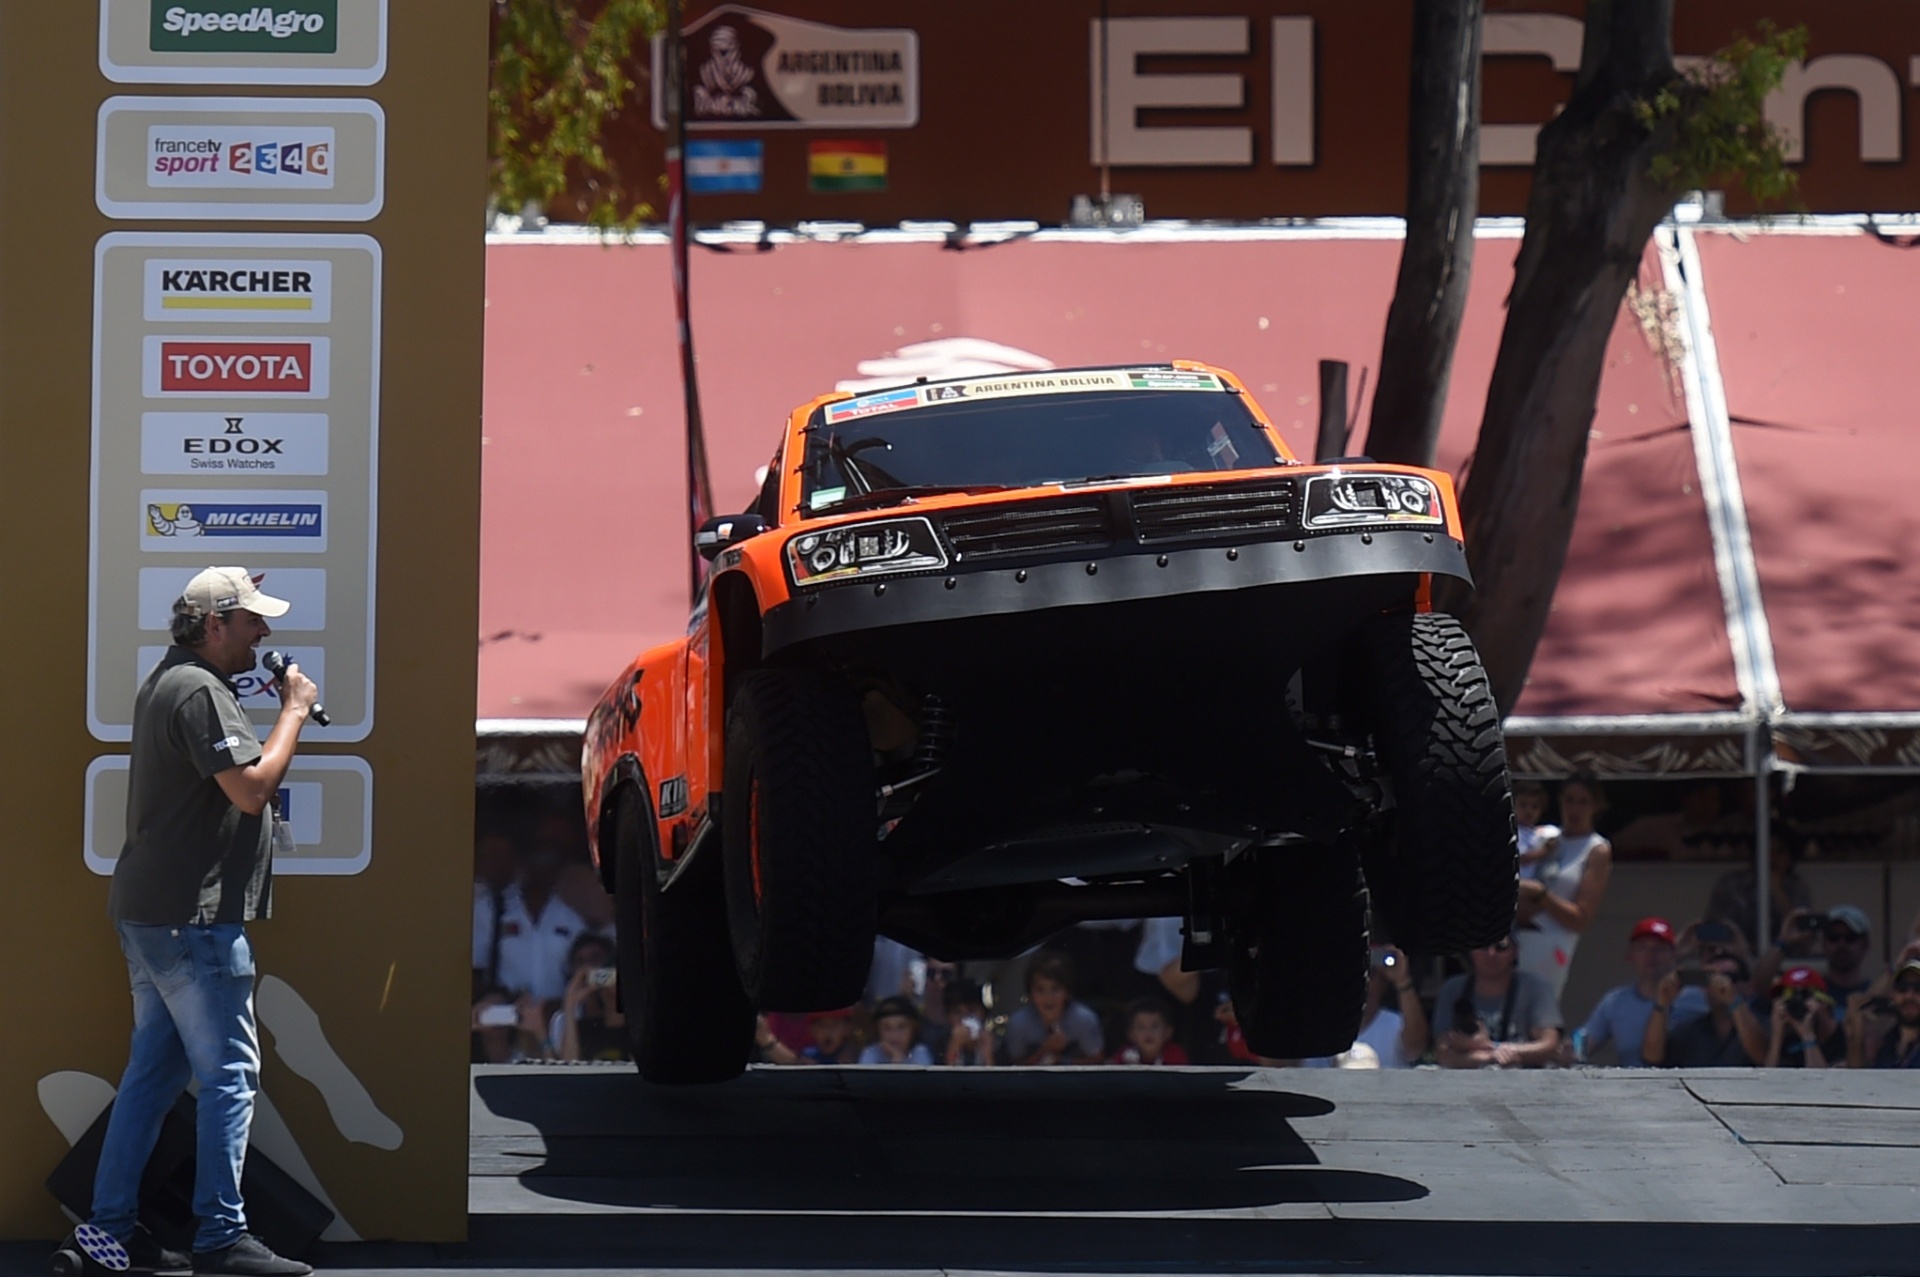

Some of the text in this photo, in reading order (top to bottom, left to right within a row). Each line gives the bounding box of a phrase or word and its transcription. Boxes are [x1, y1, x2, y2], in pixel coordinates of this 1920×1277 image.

[163, 7, 324, 38] SpeedAgro
[776, 52, 902, 74] ARGENTINA
[817, 83, 903, 107] BOLIVIA
[1090, 15, 1315, 166] El
[155, 138, 222, 153] francetv
[155, 154, 220, 176] sport
[161, 269, 312, 292] KÄRCHER
[168, 355, 303, 380] TOYOTA
[975, 376, 1115, 394] ARGENTINA BOLIVIA
[851, 402, 899, 416] TOTAL
[183, 438, 284, 454] EDOX
[191, 458, 275, 469] Swiss Watches
[205, 512, 319, 526] MICHELIN
